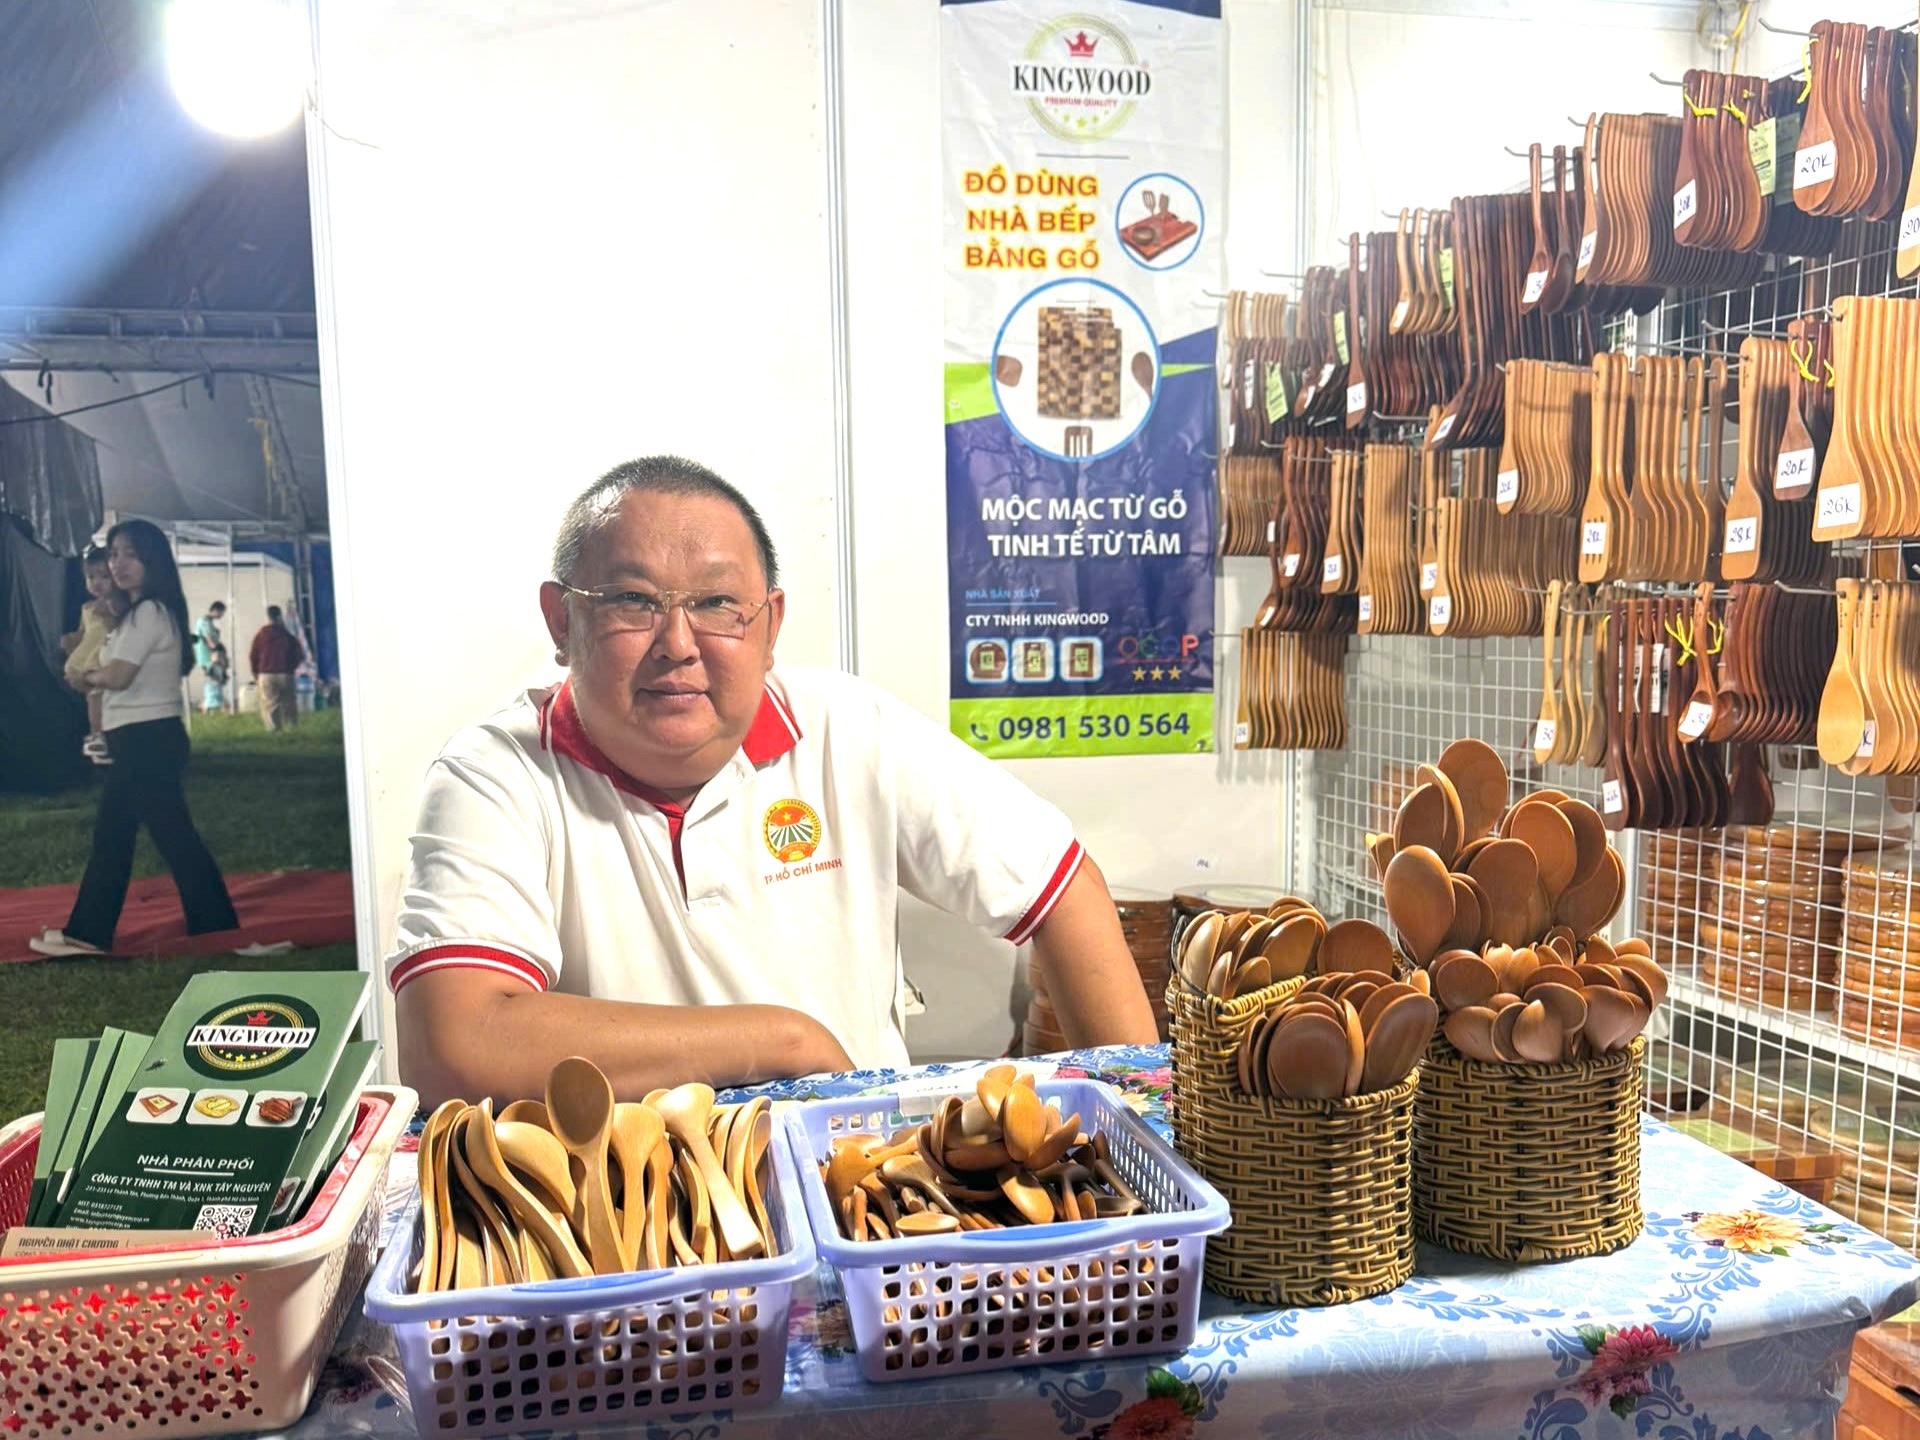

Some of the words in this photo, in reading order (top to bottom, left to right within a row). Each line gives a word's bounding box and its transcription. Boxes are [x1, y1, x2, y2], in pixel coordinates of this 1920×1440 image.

[1013, 66, 1151, 96] KINGWOOD
[1044, 96, 1082, 106] PREMIUM
[1083, 98, 1118, 107] QUALITY
[1800, 153, 1833, 175] 20K
[1015, 168, 1098, 197] DÙNG
[967, 204, 1030, 232] NHÀ
[1038, 203, 1096, 232] BẾP
[965, 238, 1047, 268] BẰNG
[1056, 239, 1100, 269] GỖ
[1780, 457, 1809, 477] 20K
[982, 494, 1043, 526] MỘC
[1048, 497, 1105, 526] MẠC
[1109, 493, 1145, 520] TỪ
[1149, 489, 1188, 520] GỖ
[1822, 495, 1855, 516] 26K
[987, 534, 1050, 557] TINH
[1053, 527, 1086, 556] TẾ
[1087, 530, 1125, 556] TỪ
[1126, 529, 1182, 555] TÂM
[965, 614, 991, 627] CTY
[993, 614, 1031, 627] TNHH
[1033, 612, 1110, 626] KINGWOOD
[998, 716, 1066, 741] 0981
[1078, 713, 1131, 739] 530
[1138, 712, 1190, 737] 564
[793, 862, 813, 877] CHÍ
[815, 858, 842, 873] MINH
[191, 1028, 310, 1044] KINGWOOD
[137, 1153, 170, 1166] NHÀ
[172, 1155, 215, 1169] PHÂN
[216, 1156, 255, 1170] PHỐI
[91, 1172, 118, 1185] CÔNG
[120, 1176, 133, 1186] TY
[133, 1177, 161, 1189] TNHH
[163, 1179, 178, 1190] TM
[180, 1181, 192, 1191] VÀ
[193, 1182, 212, 1192] XNK
[214, 1181, 232, 1192] TÂY
[232, 1182, 271, 1193] NGUYÊN
